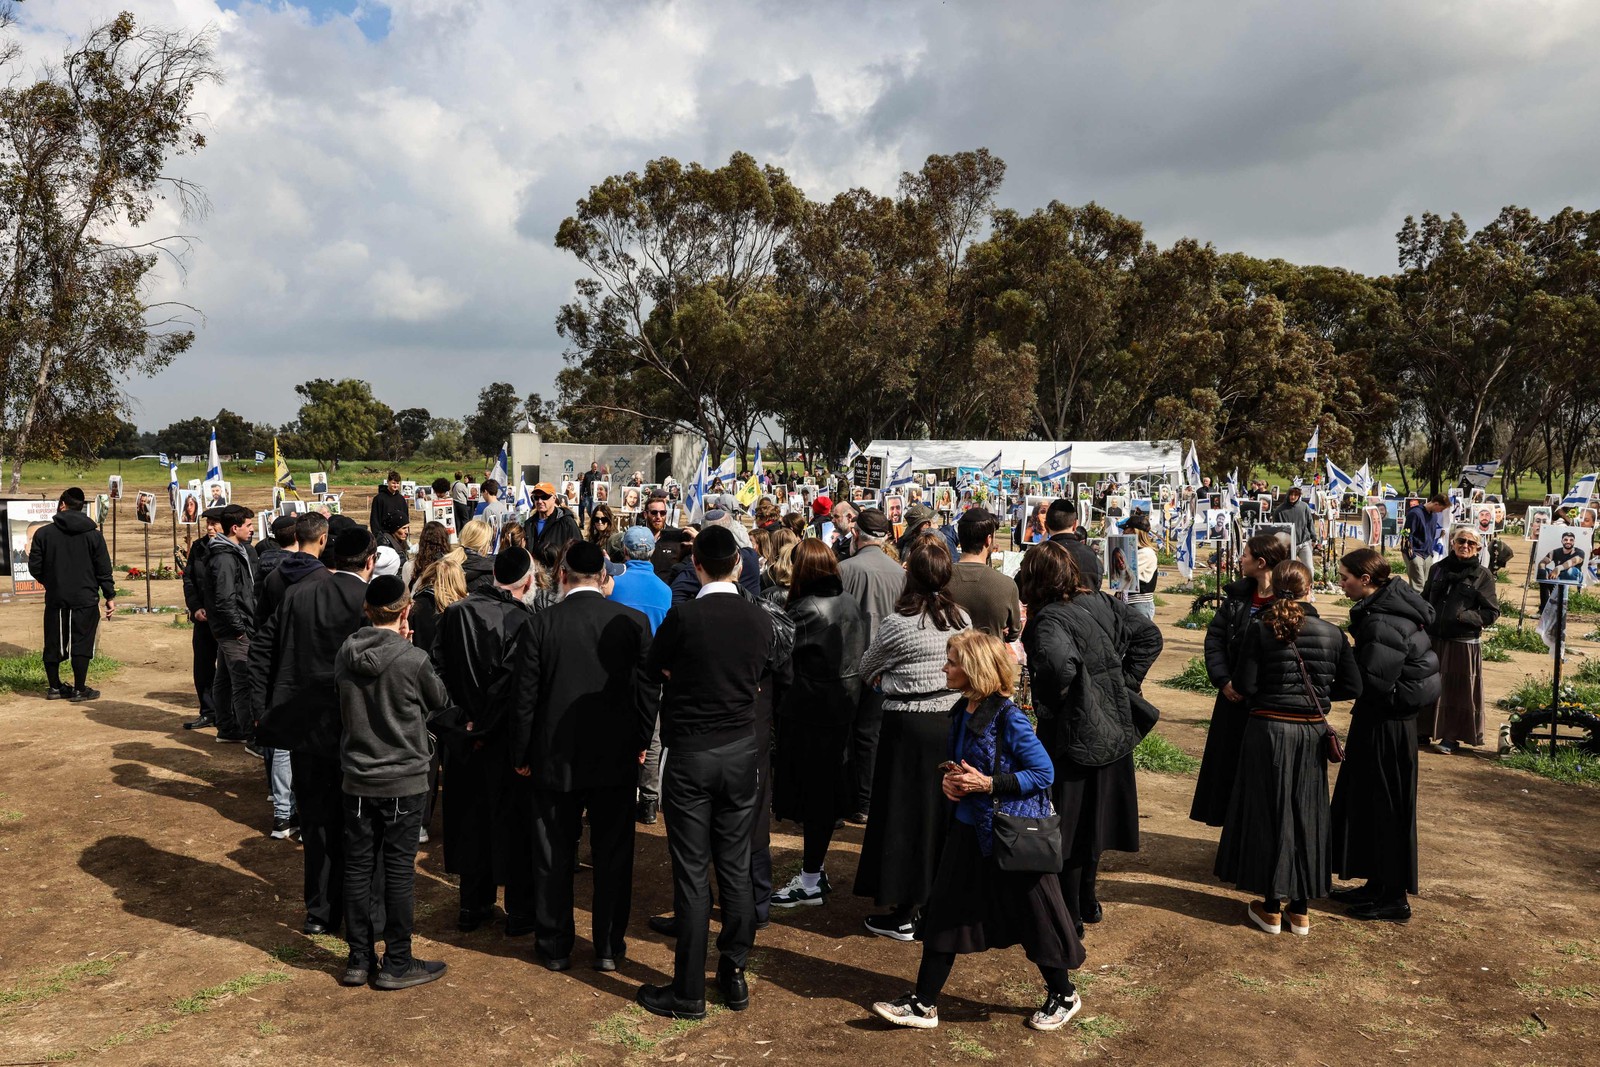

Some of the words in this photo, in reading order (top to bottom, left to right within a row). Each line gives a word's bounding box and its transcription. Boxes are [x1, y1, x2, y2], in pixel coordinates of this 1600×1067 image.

[13, 562, 28, 572] BRIN
[15, 581, 33, 591] HOME
[34, 581, 44, 590] NO
